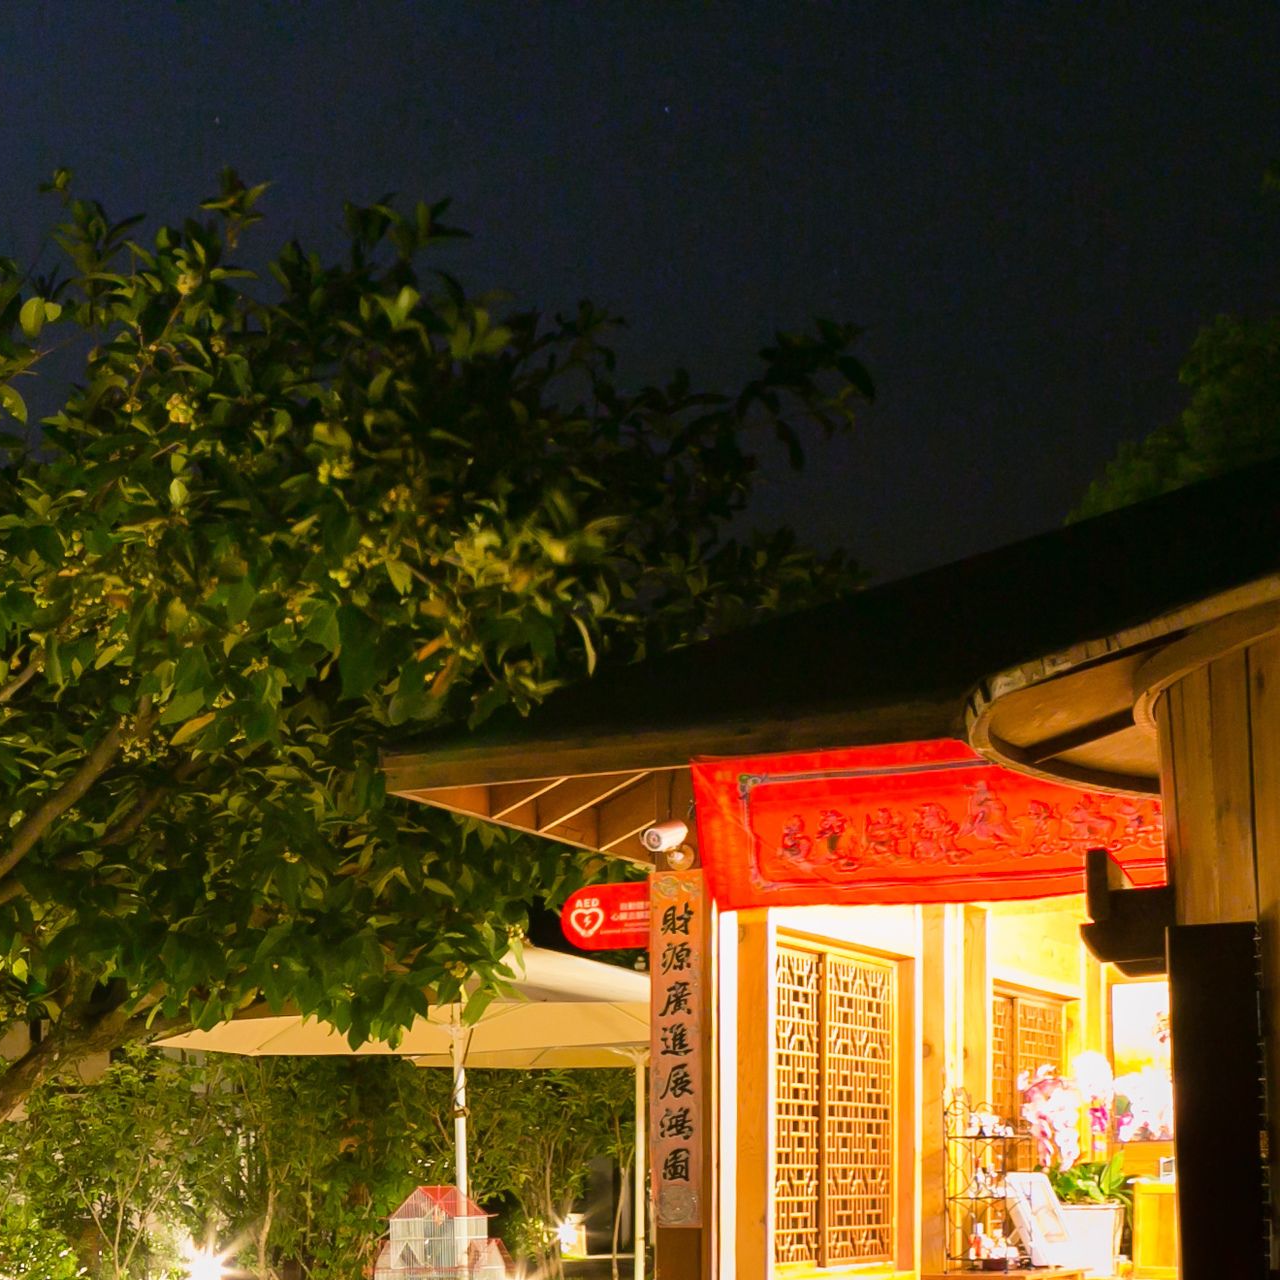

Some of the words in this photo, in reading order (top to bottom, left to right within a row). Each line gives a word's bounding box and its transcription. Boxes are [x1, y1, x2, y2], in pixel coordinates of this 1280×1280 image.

[575, 898, 600, 908] AED
[659, 903, 694, 1182] 財源廣進展鴻圖
